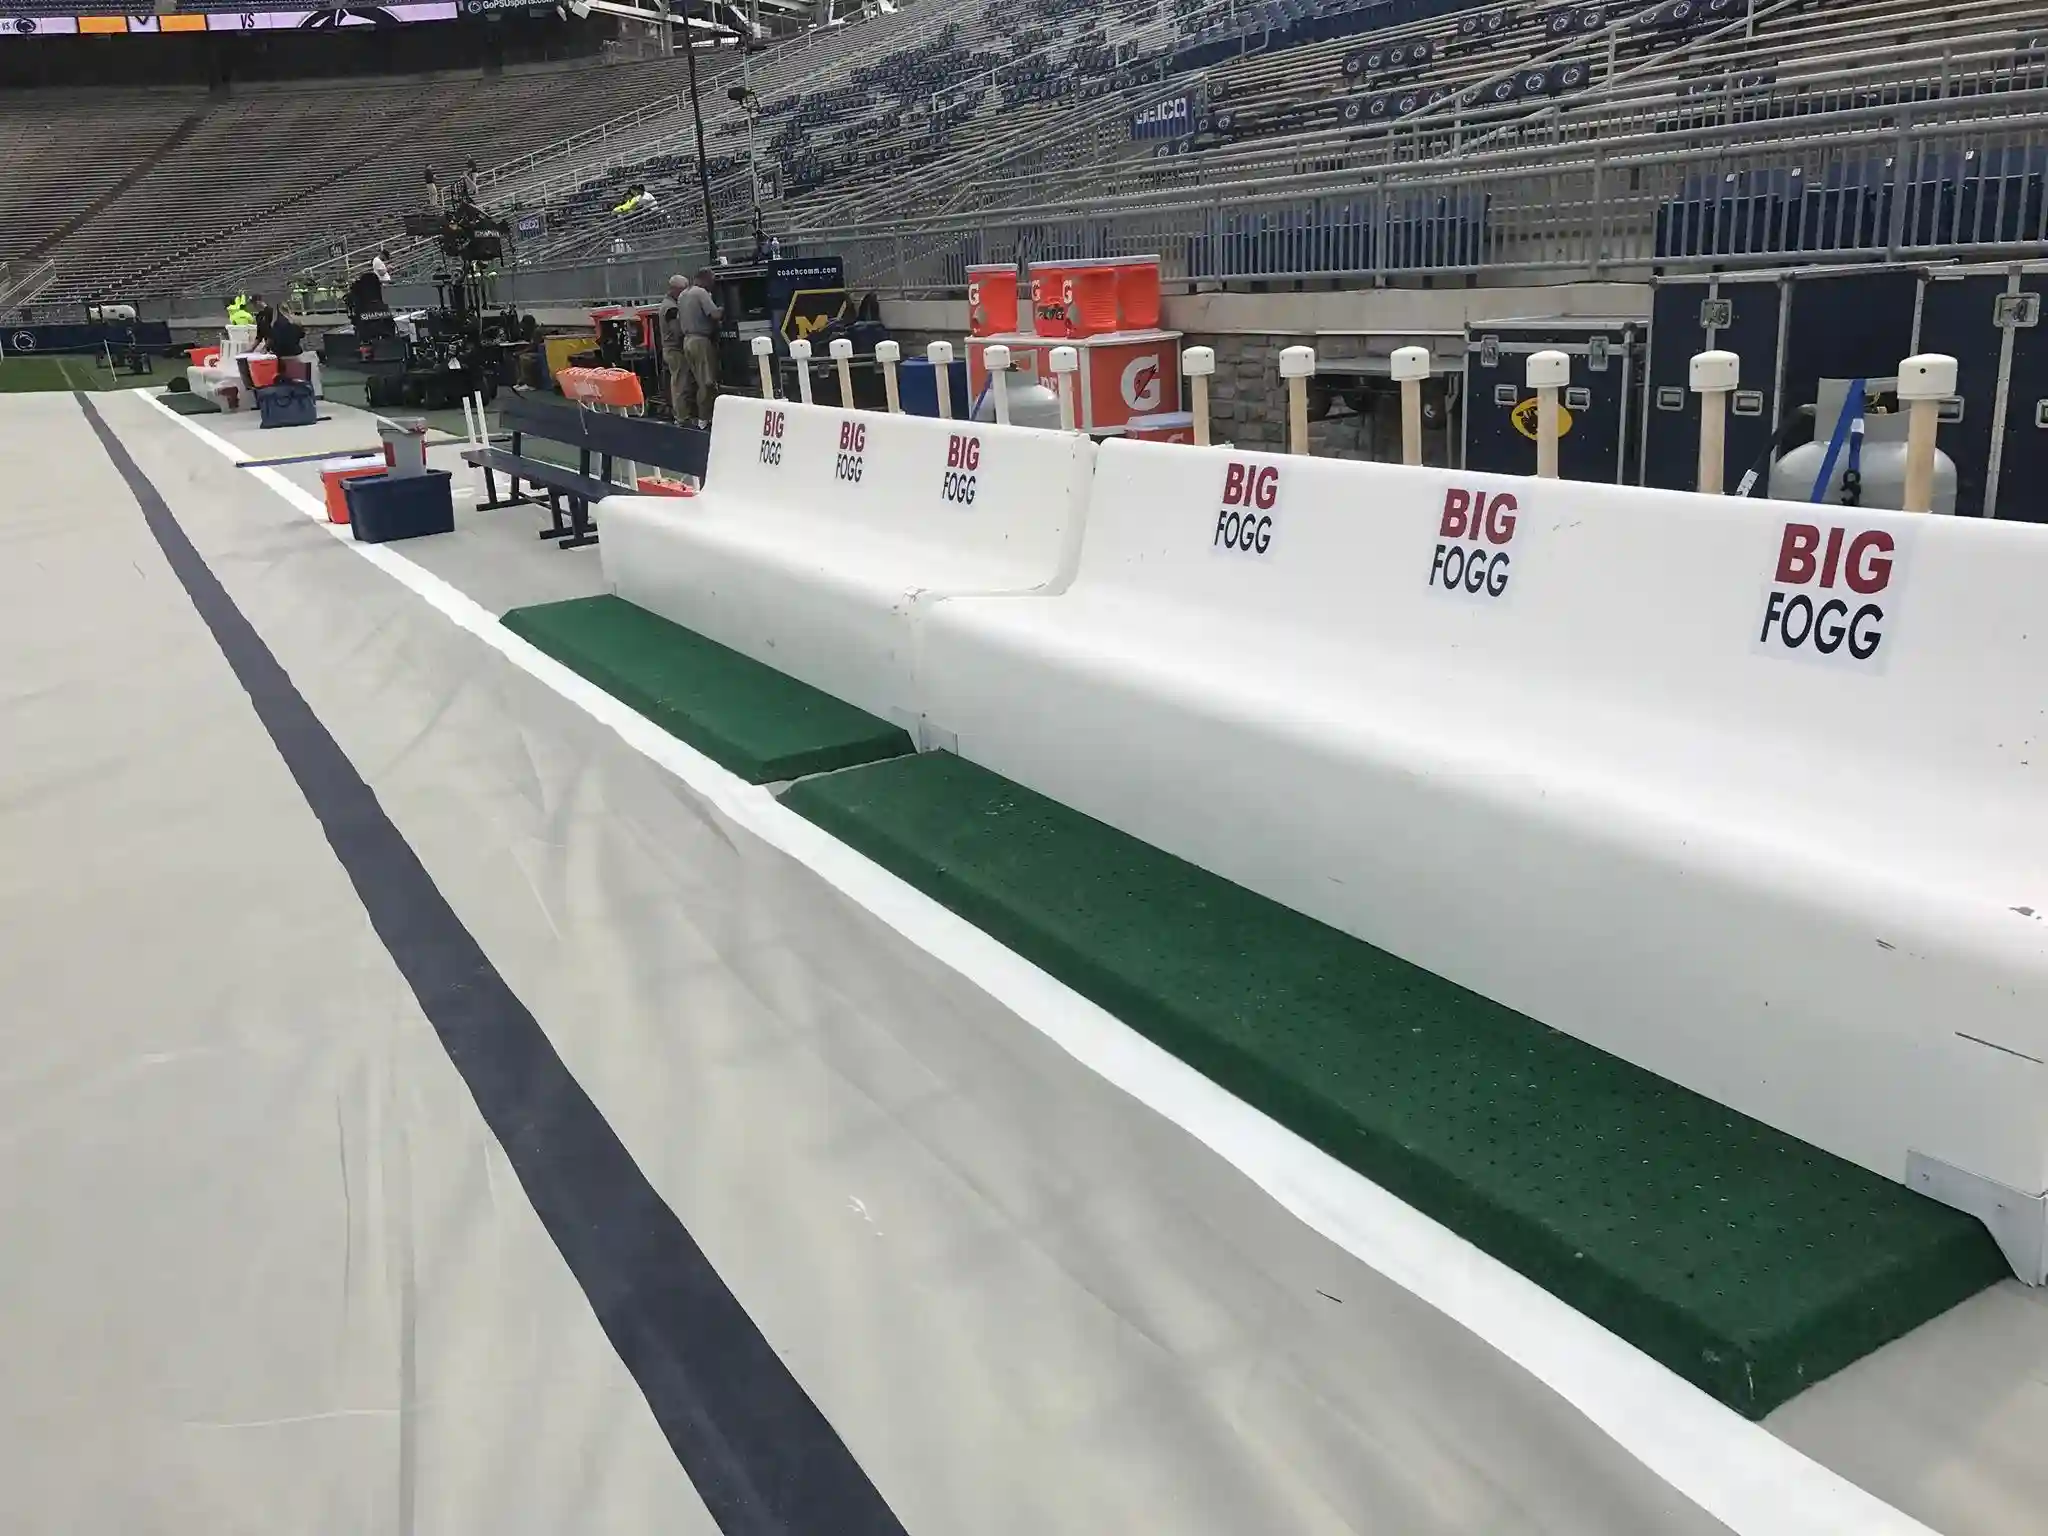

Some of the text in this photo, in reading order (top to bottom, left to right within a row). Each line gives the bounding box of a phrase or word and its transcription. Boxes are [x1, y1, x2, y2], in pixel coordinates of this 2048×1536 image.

[240, 12, 255, 29] VS
[777, 267, 837, 276] coachcomm.com
[968, 283, 980, 305] G
[1031, 279, 1041, 301] G
[1062, 280, 1073, 303] G
[1121, 353, 1160, 411] G
[763, 410, 784, 438] BIG
[840, 421, 865, 452] BIG
[759, 440, 782, 465] FOGG
[836, 453, 863, 482] FOGG
[948, 435, 980, 471] BIG
[942, 472, 976, 505] FOGG
[1223, 463, 1279, 509] BIG
[1214, 510, 1272, 554] FOGG
[1440, 488, 1518, 545] BIG
[1429, 544, 1510, 597] FOGG
[1775, 523, 1895, 594] BIG
[1760, 591, 1884, 660] FOGG
